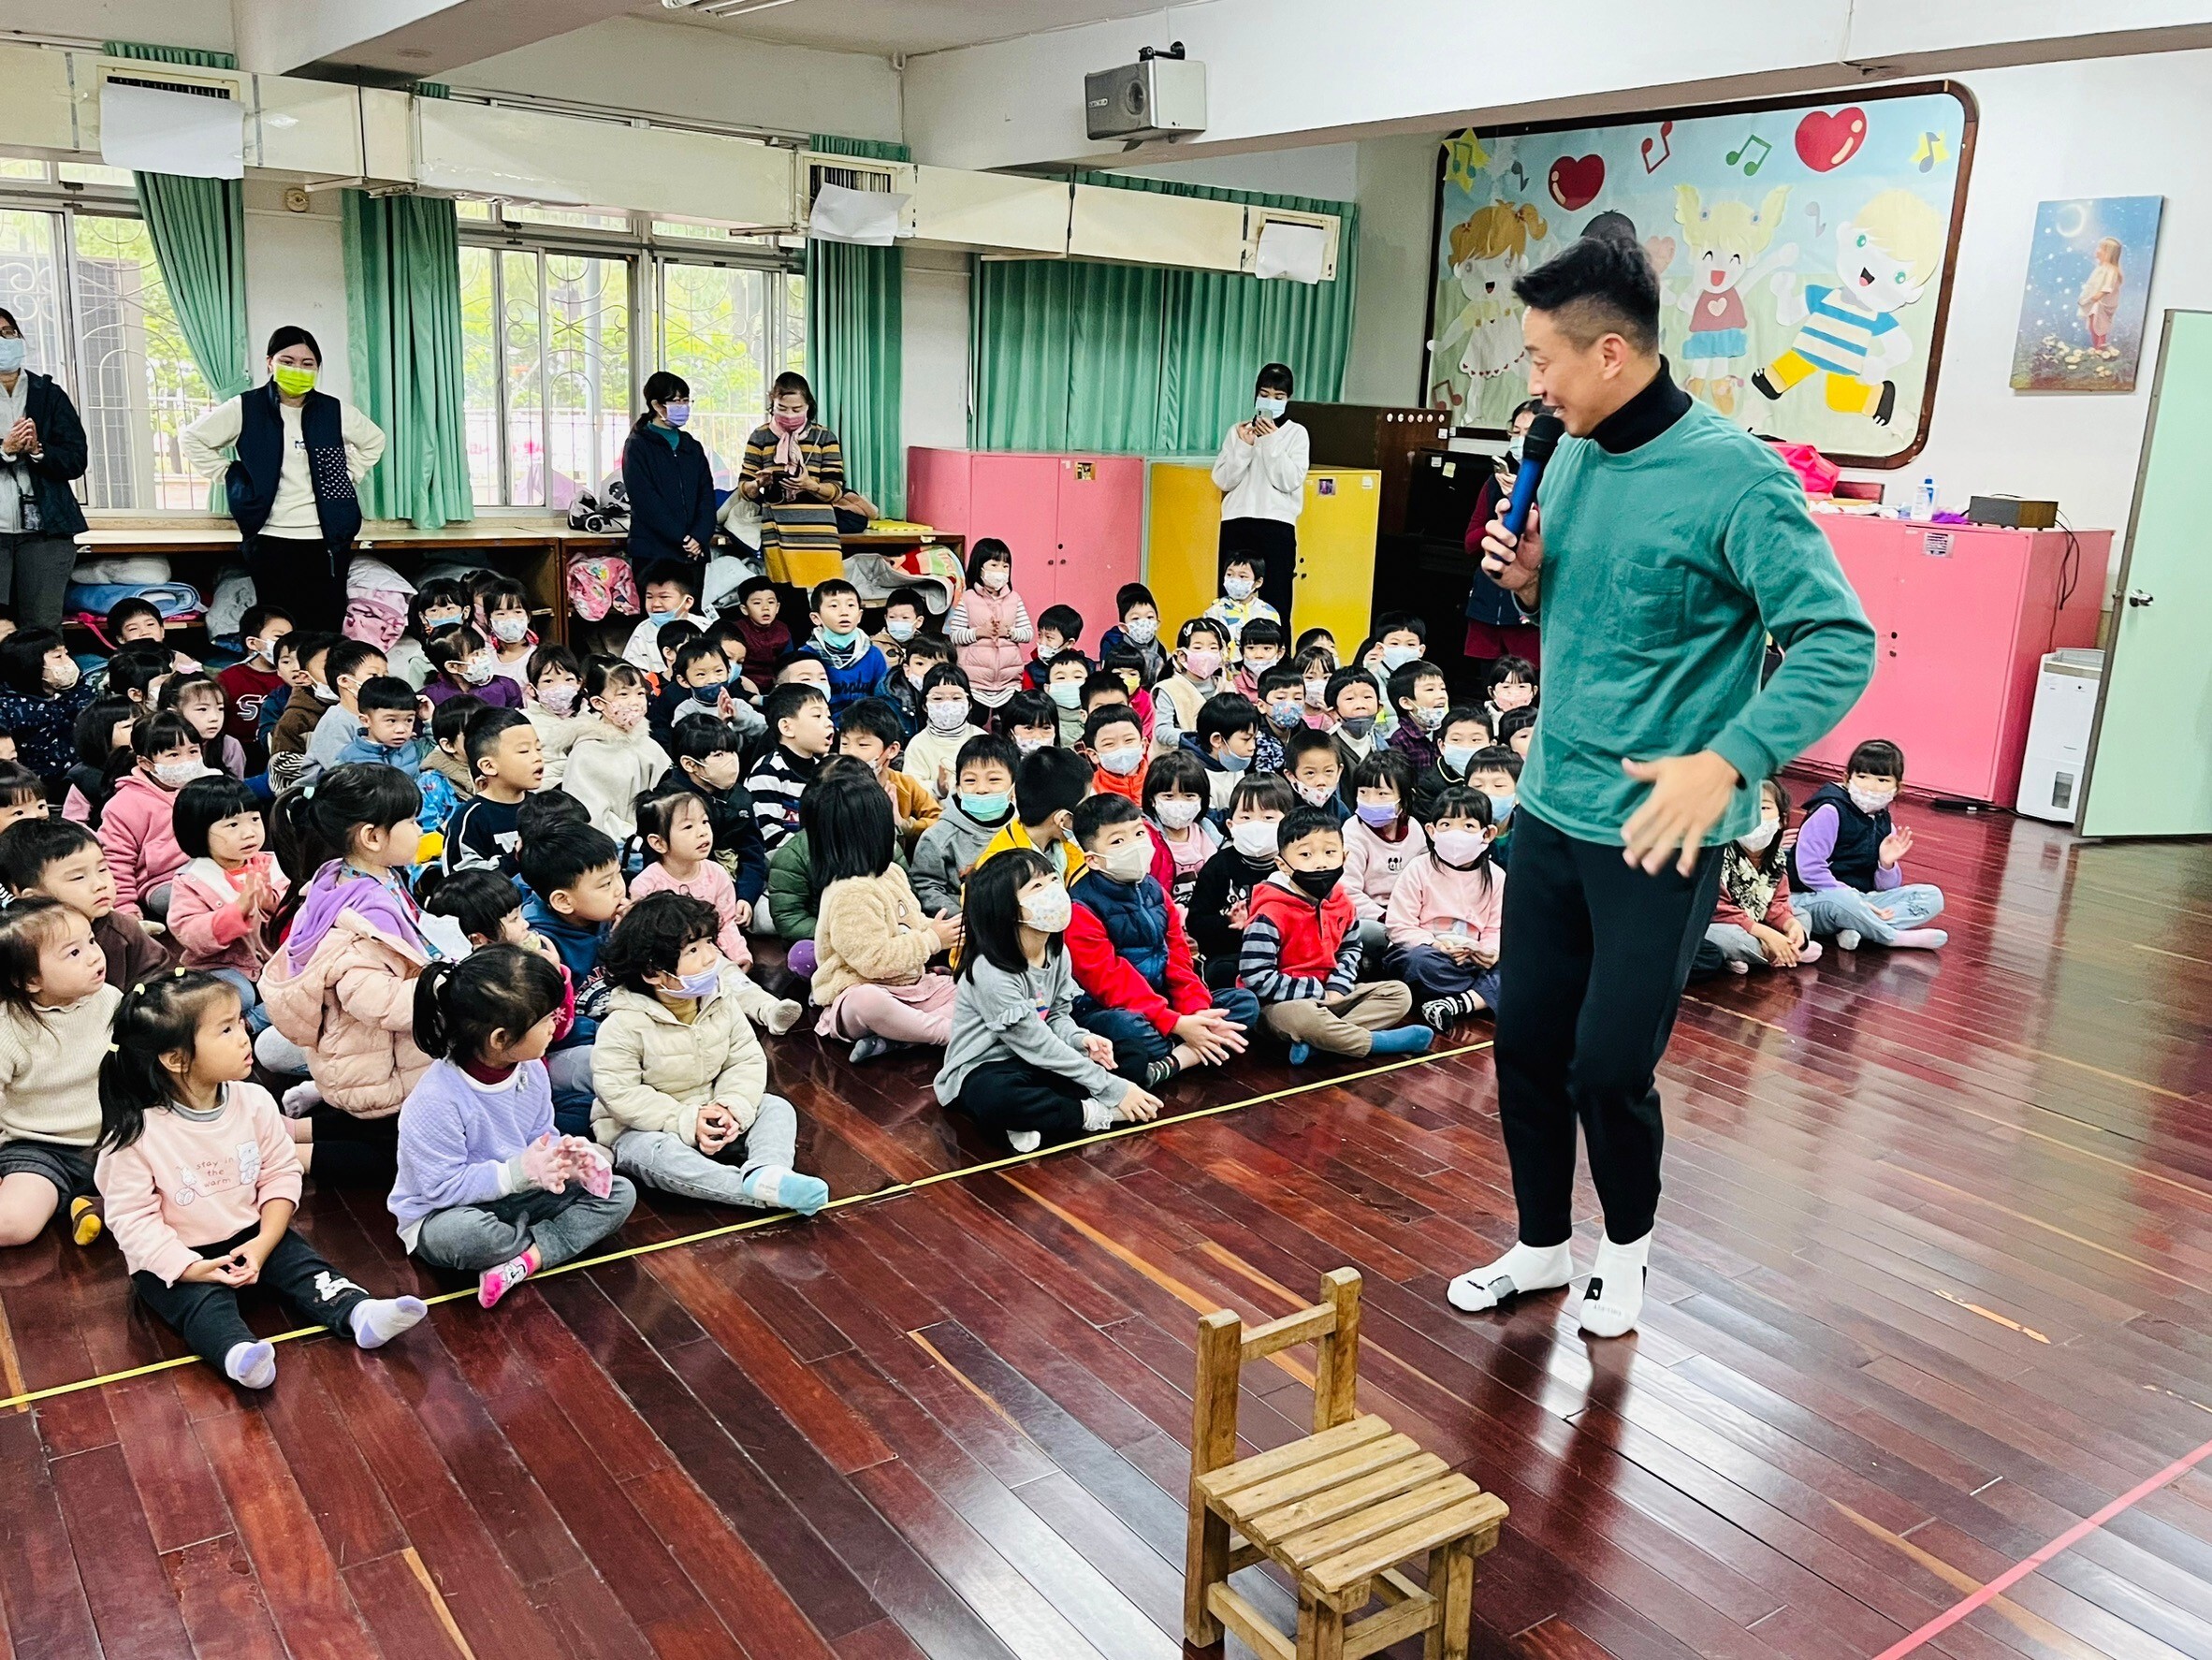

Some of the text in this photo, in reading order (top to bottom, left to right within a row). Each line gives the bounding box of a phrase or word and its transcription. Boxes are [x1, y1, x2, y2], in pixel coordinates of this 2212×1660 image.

[196, 1160, 219, 1171] stay
[207, 1169, 225, 1177] the
[203, 1178, 232, 1188] warm
